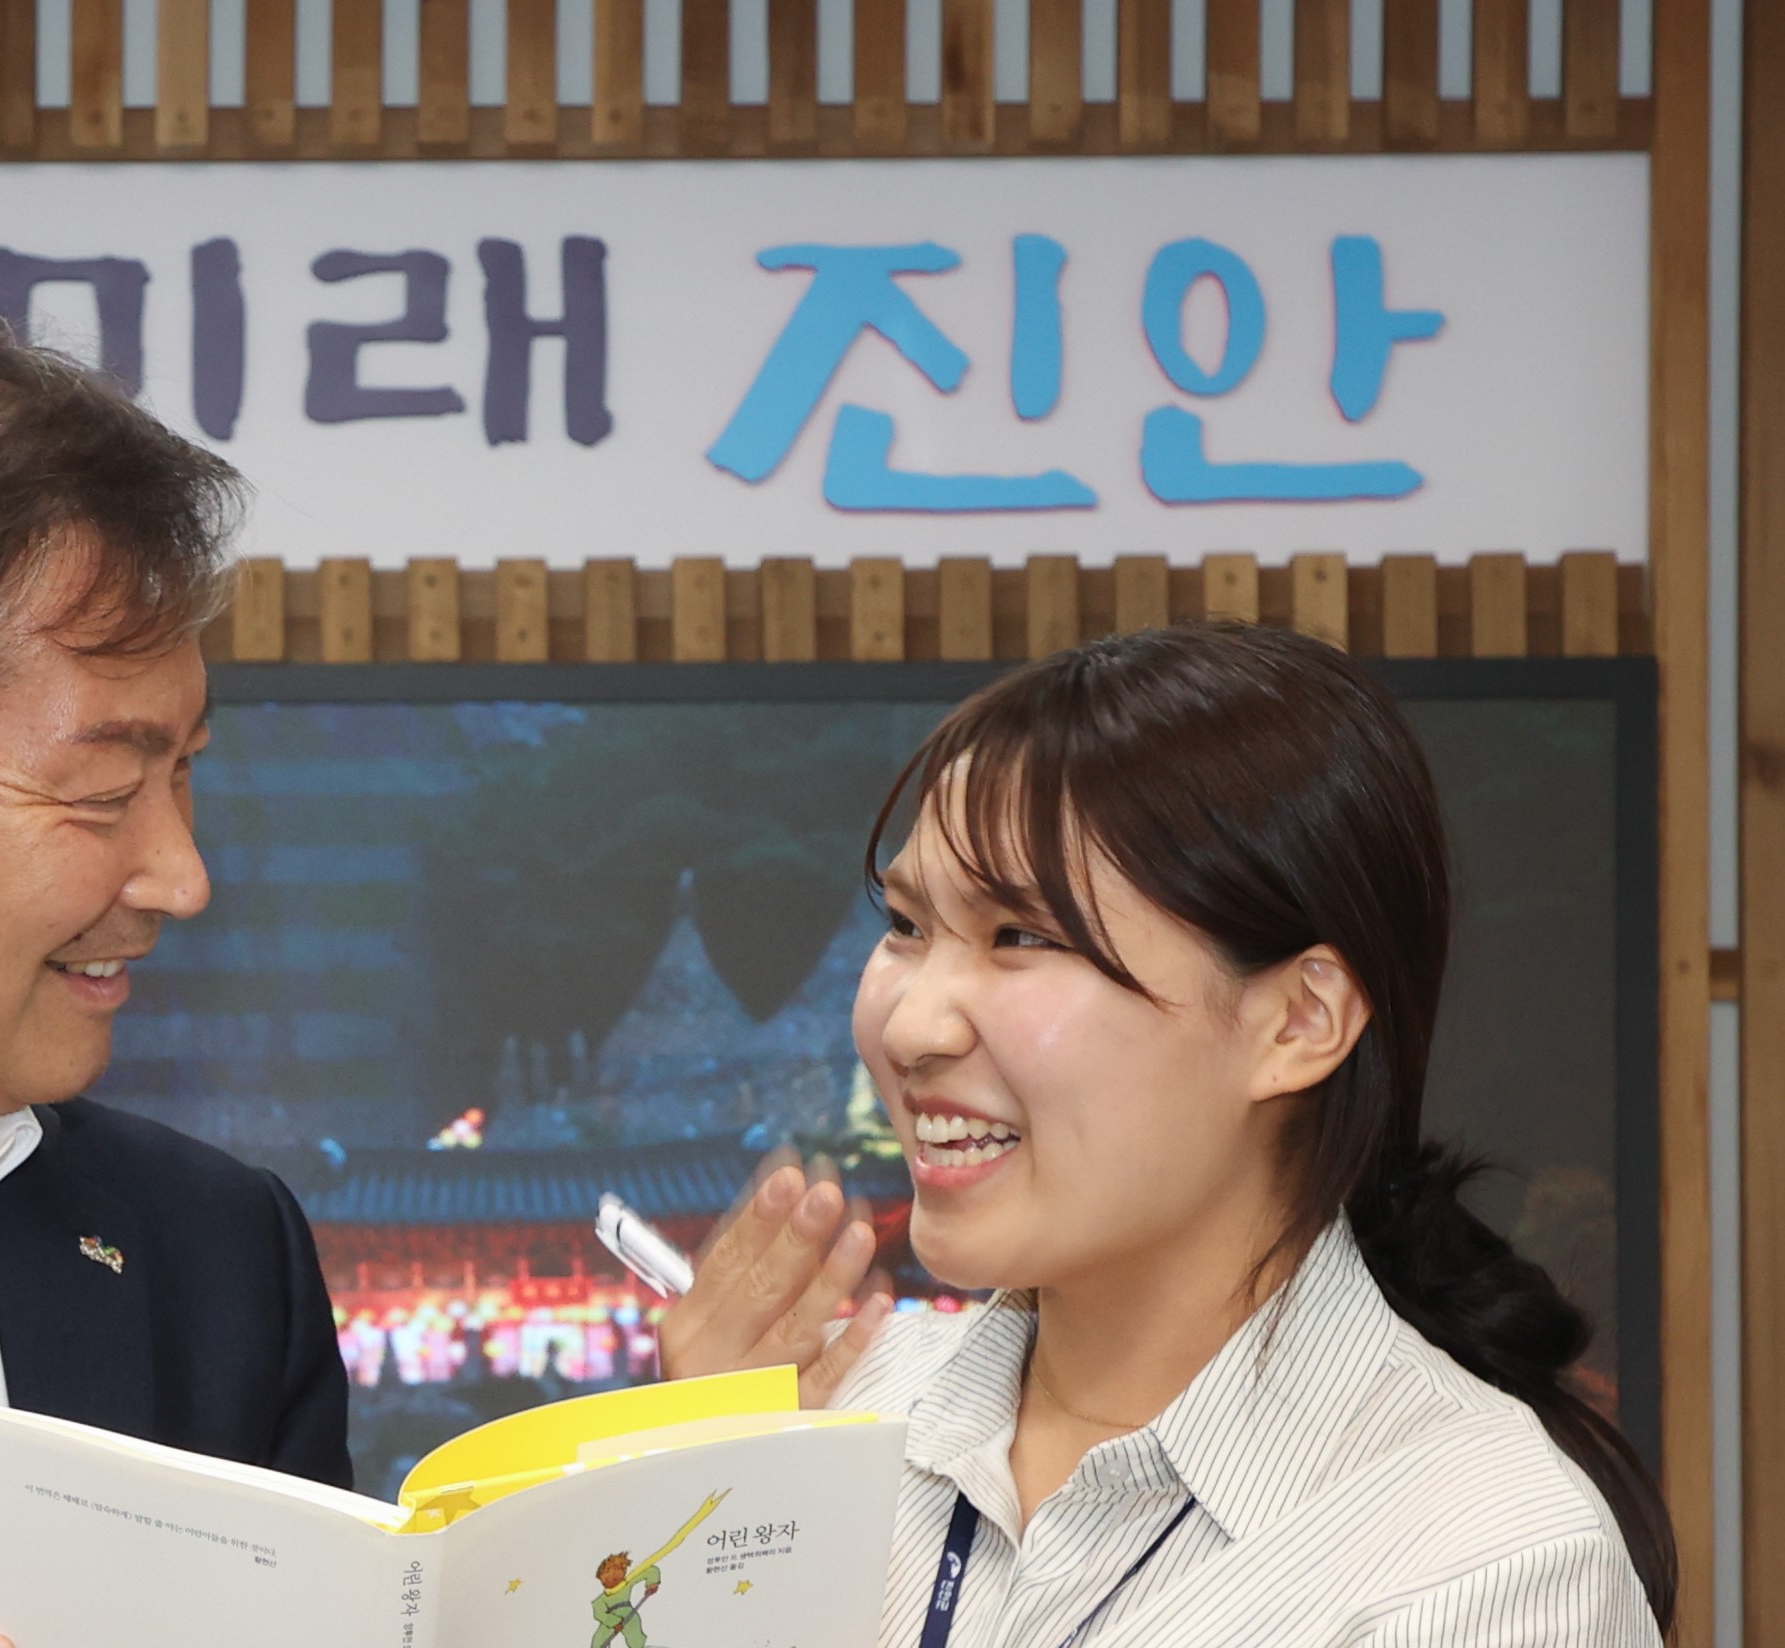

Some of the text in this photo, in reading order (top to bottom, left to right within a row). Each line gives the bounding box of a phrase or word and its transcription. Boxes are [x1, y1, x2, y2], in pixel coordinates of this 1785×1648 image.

[706, 233, 1446, 513] 진안
[706, 1520, 800, 1551] 어린 왕자
[403, 1561, 423, 1586] 어린
[400, 1589, 421, 1616] 왕자
